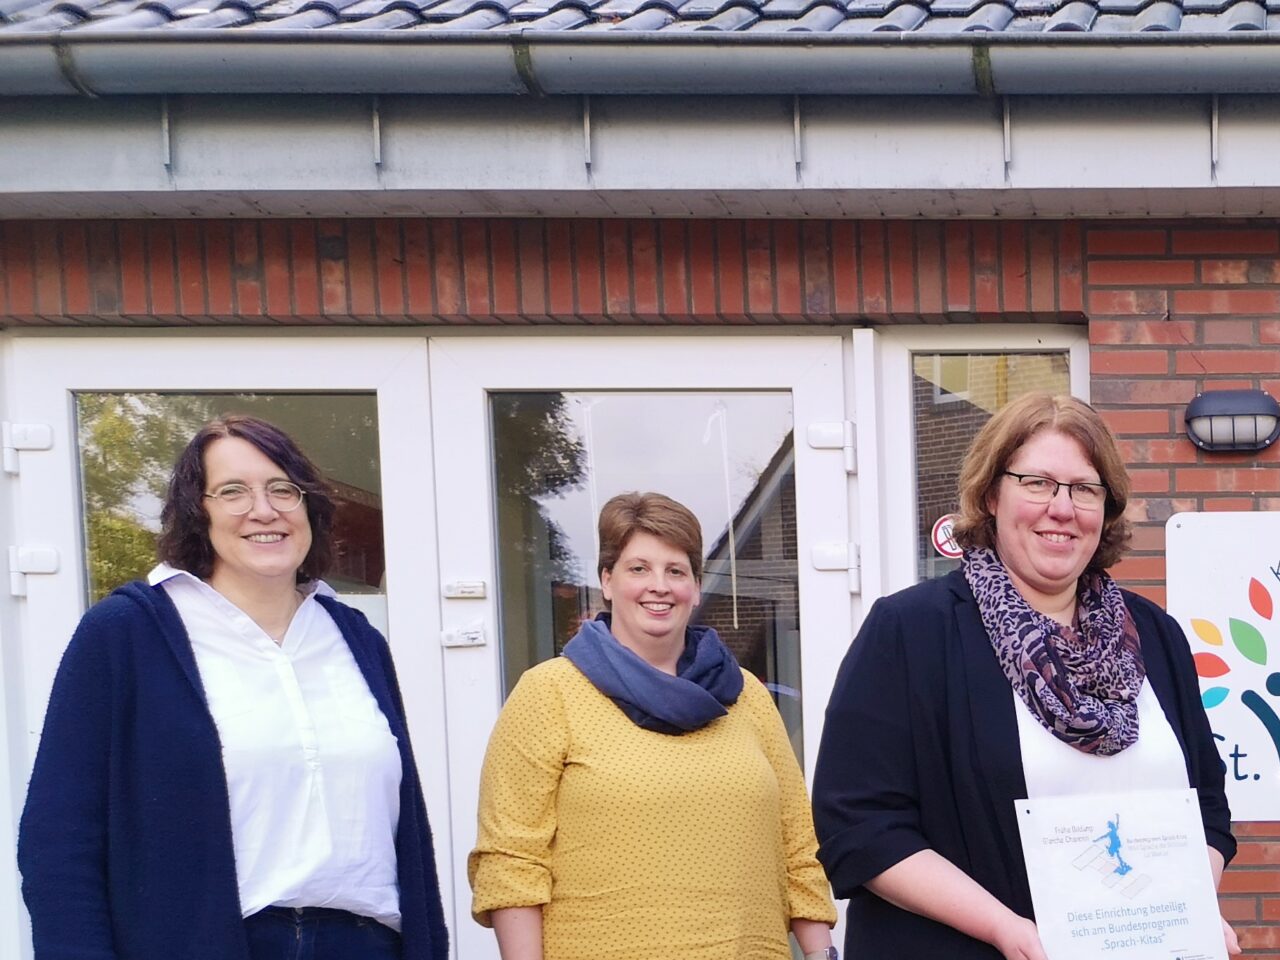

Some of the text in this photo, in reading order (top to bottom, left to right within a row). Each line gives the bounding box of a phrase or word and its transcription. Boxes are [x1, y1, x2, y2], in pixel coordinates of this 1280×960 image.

[1067, 901, 1187, 922] Diese Einrichtung beteiligt
[1071, 917, 1190, 938] sich am Bundesprogramm
